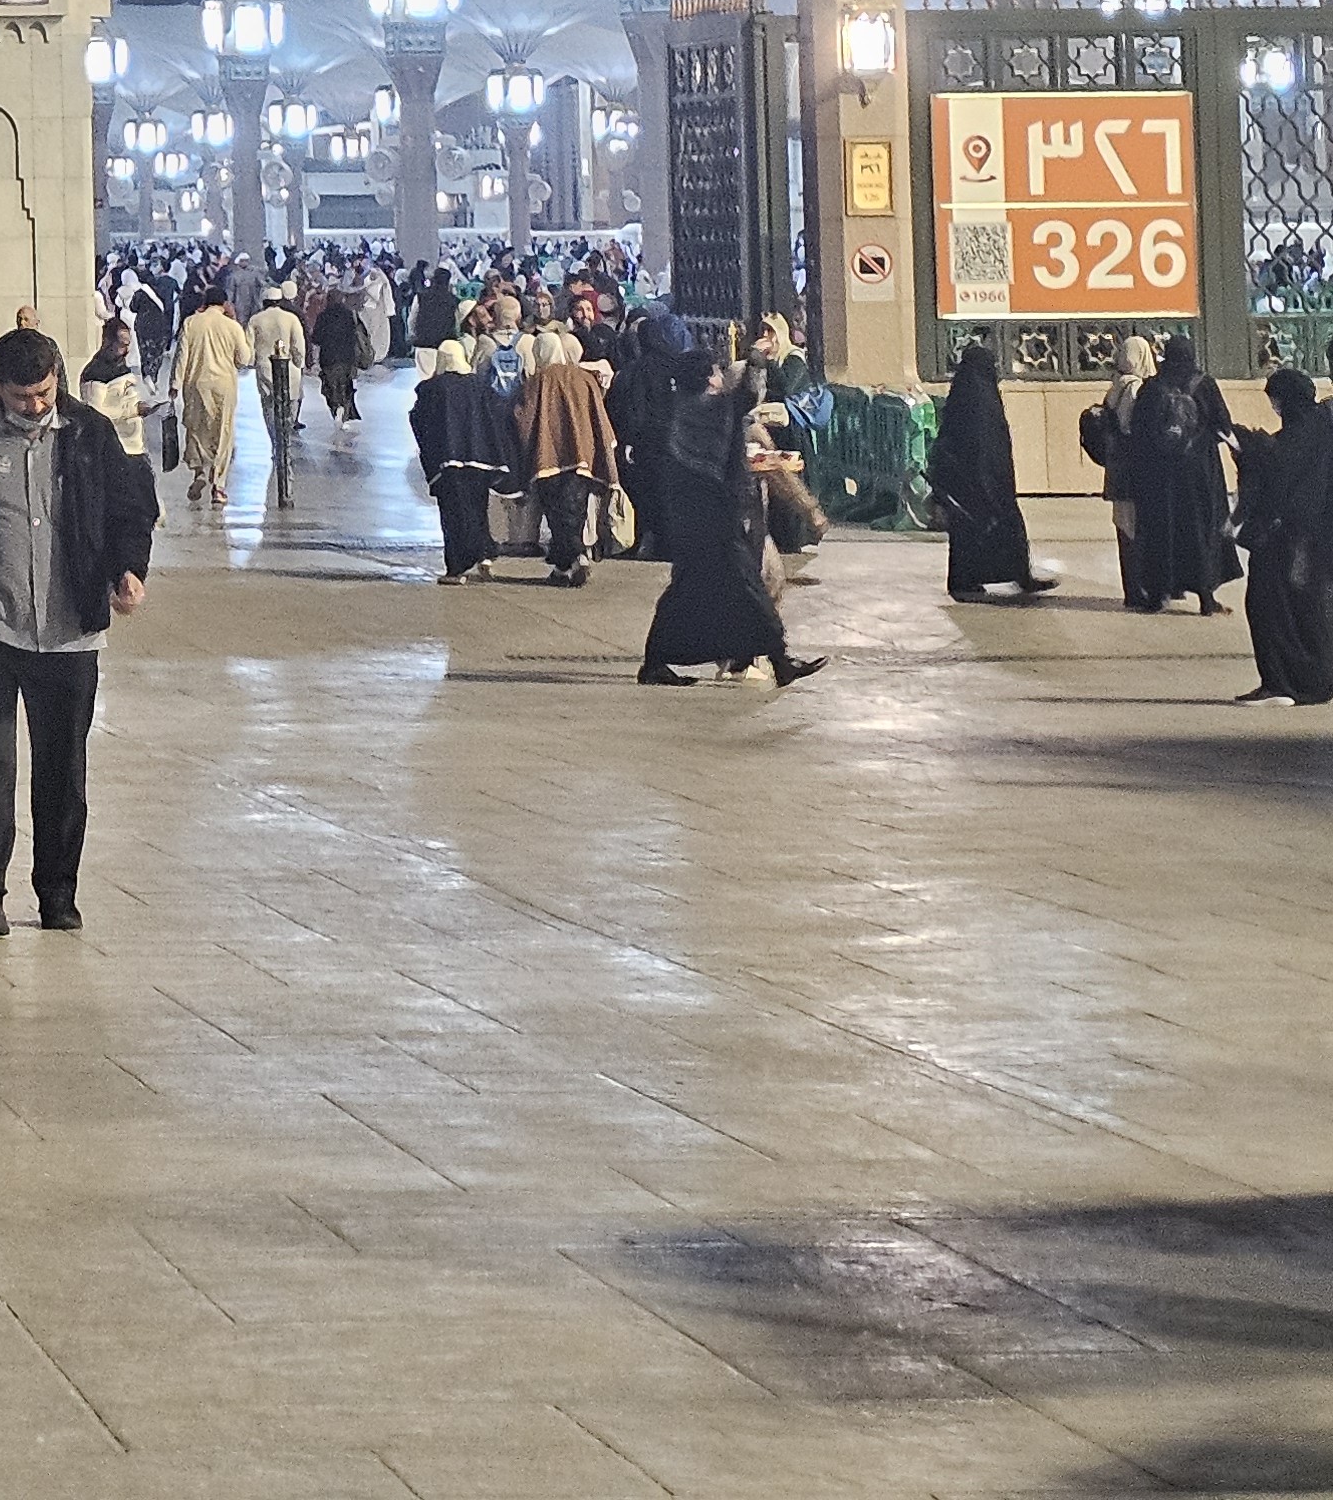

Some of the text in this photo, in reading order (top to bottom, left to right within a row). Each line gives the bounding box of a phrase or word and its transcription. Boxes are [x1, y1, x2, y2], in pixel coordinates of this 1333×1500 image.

[1027, 118, 1183, 196] ٣٢٦
[1032, 218, 1188, 290] 326
[973, 290, 1007, 303] 1966
